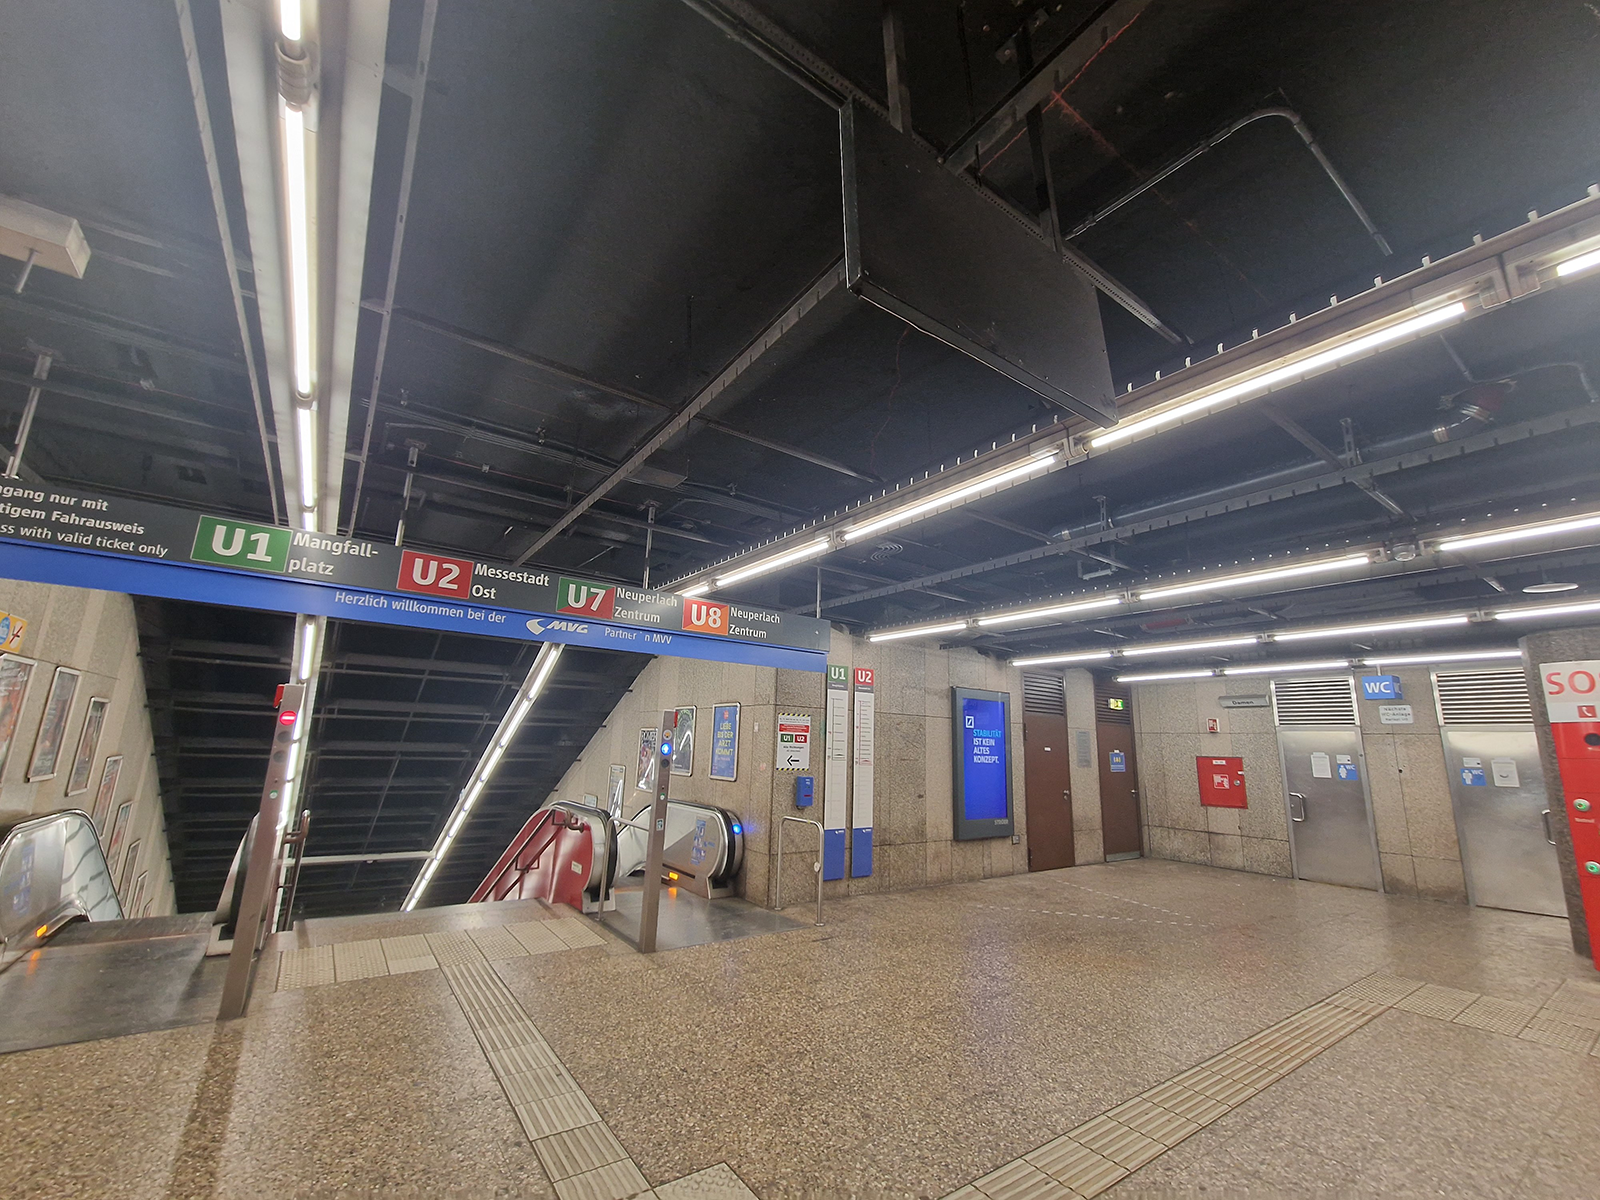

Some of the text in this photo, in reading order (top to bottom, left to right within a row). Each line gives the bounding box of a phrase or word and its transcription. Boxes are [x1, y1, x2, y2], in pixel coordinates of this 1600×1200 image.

[0, 484, 109, 512] gang nur mit
[51, 511, 145, 536] Fahrausweis
[20, 526, 52, 540] with
[57, 531, 92, 545] valid
[96, 536, 135, 551] ticket
[138, 543, 168, 558] only
[211, 524, 272, 562] U1
[293, 532, 379, 558] Mangfall-
[288, 557, 334, 576] platz
[412, 558, 460, 590] U2
[474, 563, 550, 587] Messestadt
[471, 584, 497, 600] Ost
[567, 583, 606, 612] U7
[616, 587, 678, 607] Neuperlach
[335, 591, 506, 623] Herzlich willkommen bei der
[614, 607, 661, 623] Zentrum
[730, 607, 780, 624] Neuperlach
[691, 603, 722, 629] U8
[547, 620, 589, 634] MVG
[604, 627, 637, 640] Partner
[652, 633, 673, 644] MVV
[729, 624, 767, 639] Zentrum
[831, 667, 846, 680] U1
[858, 670, 872, 683] U2
[1364, 681, 1391, 694] WC
[1545, 670, 1600, 696] SO
[719, 722, 732, 730] LIEBE
[973, 729, 1002, 738] STABILITÄT
[724, 731, 734, 739] DER
[973, 738, 995, 746] IST KEIN
[715, 748, 734, 756] KOMMT
[973, 746, 990, 754] ALTES
[973, 755, 1000, 764] KONZEPT.
